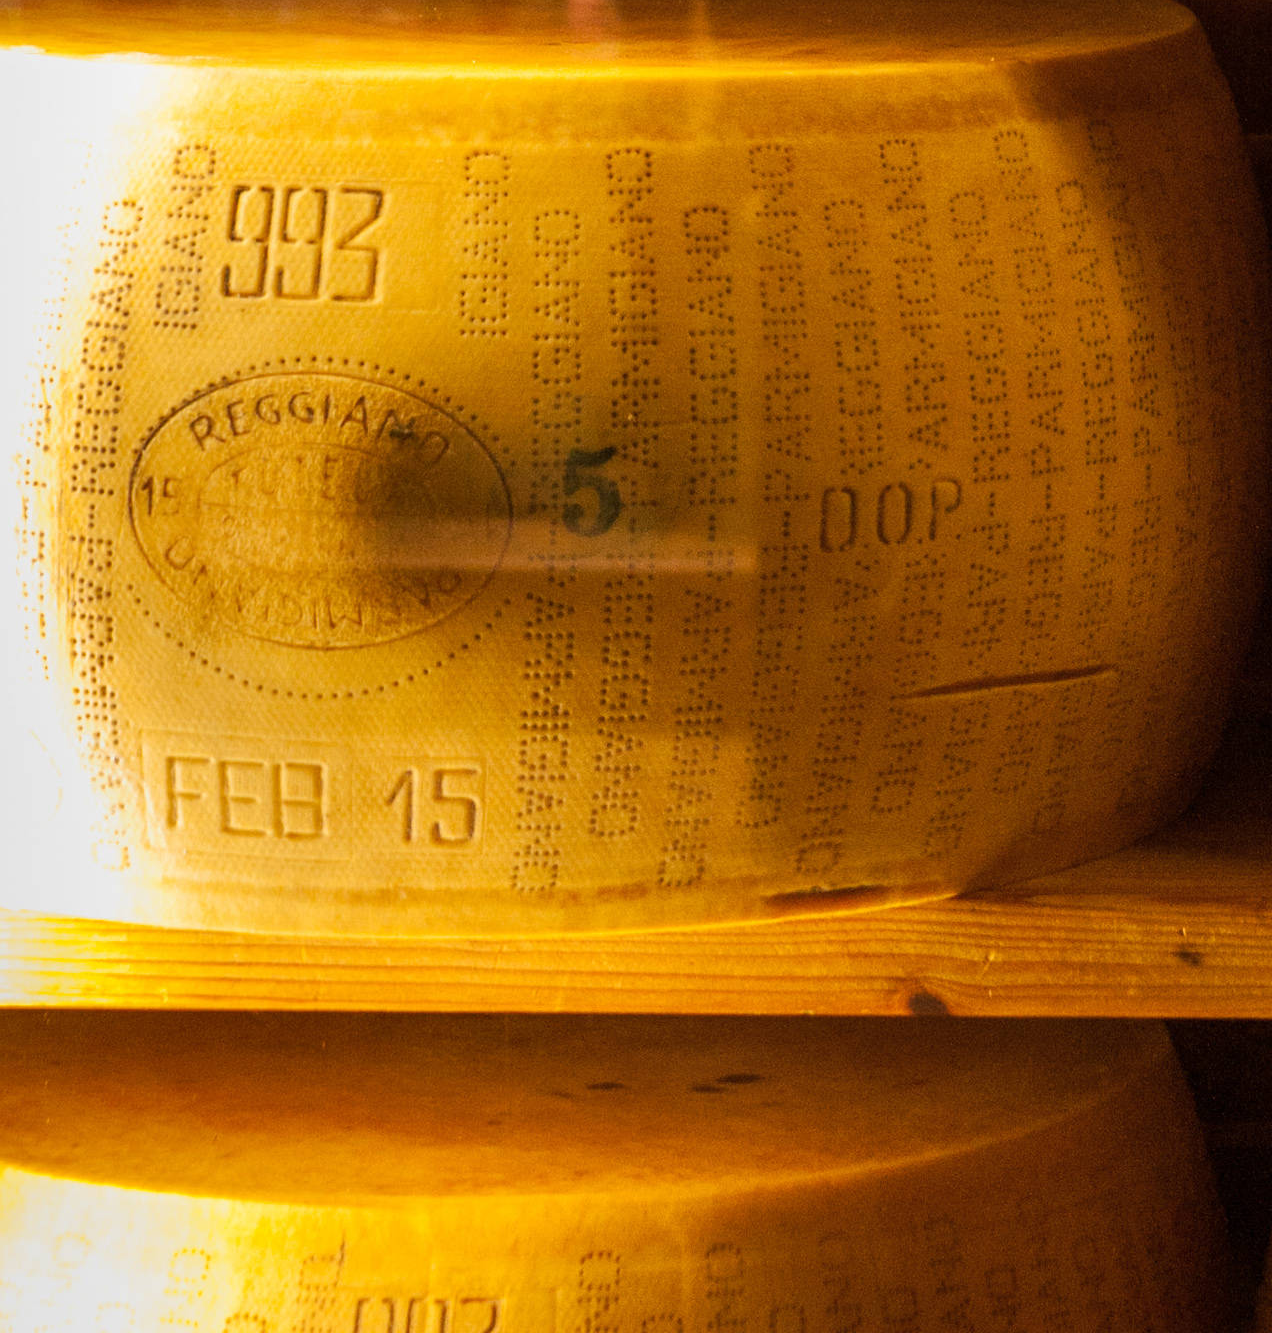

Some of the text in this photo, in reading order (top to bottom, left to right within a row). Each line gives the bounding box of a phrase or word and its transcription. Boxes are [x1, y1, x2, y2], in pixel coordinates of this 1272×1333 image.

[220, 184, 387, 303] 993
[562, 447, 625, 534] 5
[165, 753, 482, 846] FEB 15
